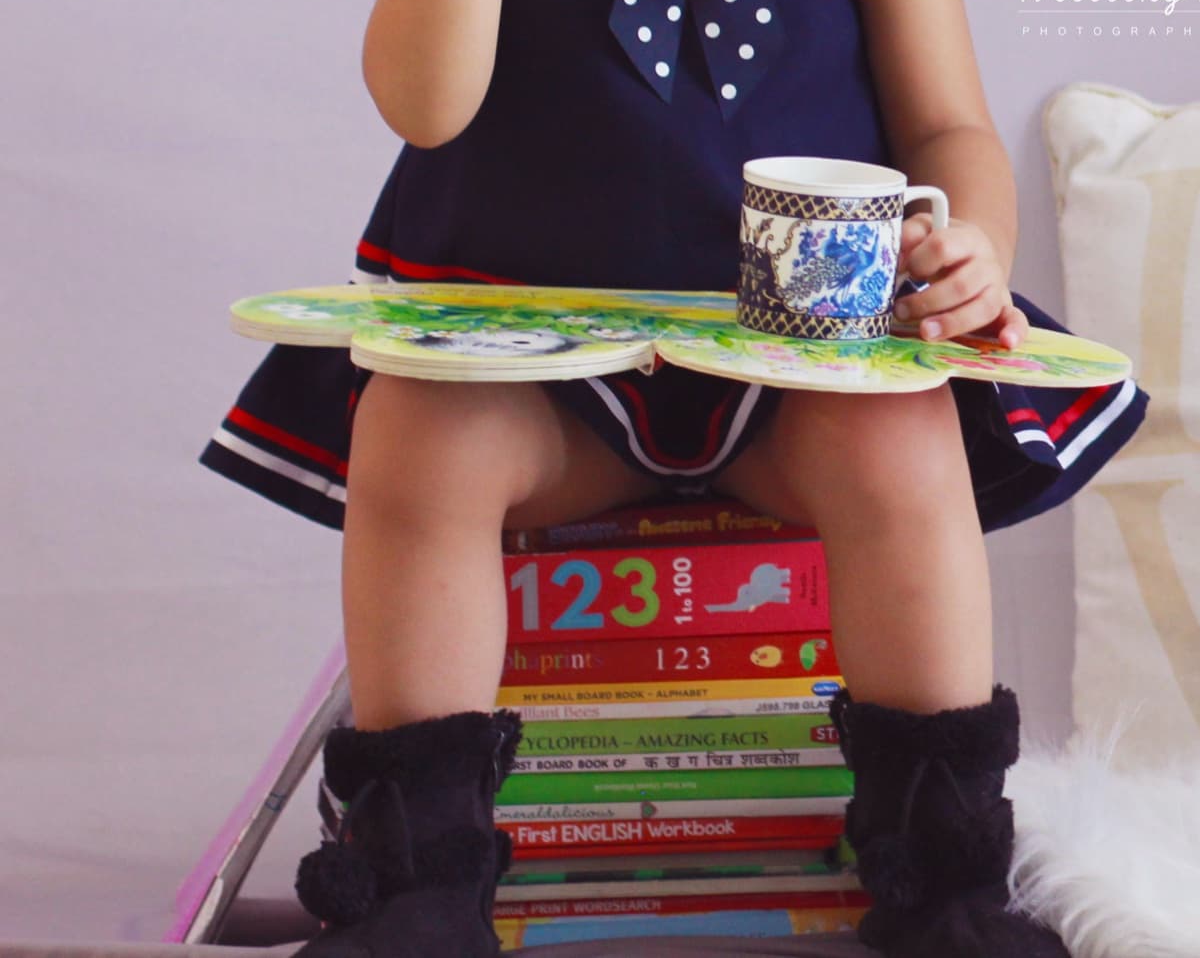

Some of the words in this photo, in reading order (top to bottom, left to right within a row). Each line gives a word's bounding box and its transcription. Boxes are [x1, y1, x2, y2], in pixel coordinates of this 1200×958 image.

[672, 557, 692, 596] 100
[681, 598, 693, 612] to
[674, 615, 693, 625] 1
[523, 693, 537, 701] MY
[541, 691, 574, 701] SMALL
[577, 691, 612, 700] BOARD
[615, 690, 644, 699] BOOK
[656, 689, 708, 698] ALPHABET
[519, 735, 618, 750] YCLOPEDIA
[637, 733, 716, 747] AMAZING
[722, 731, 769, 745] FACTS
[816, 726, 840, 741] ST
[537, 760, 574, 770] BOARD
[578, 759, 609, 769] BOOK
[613, 758, 627, 768] OF
[518, 826, 558, 843] First
[561, 822, 643, 842] ENGLISH
[647, 818, 736, 839] Workbook
[493, 904, 525, 917] ARGE
[531, 902, 568, 915] PRINT
[574, 898, 662, 914] WORDSEARCH
